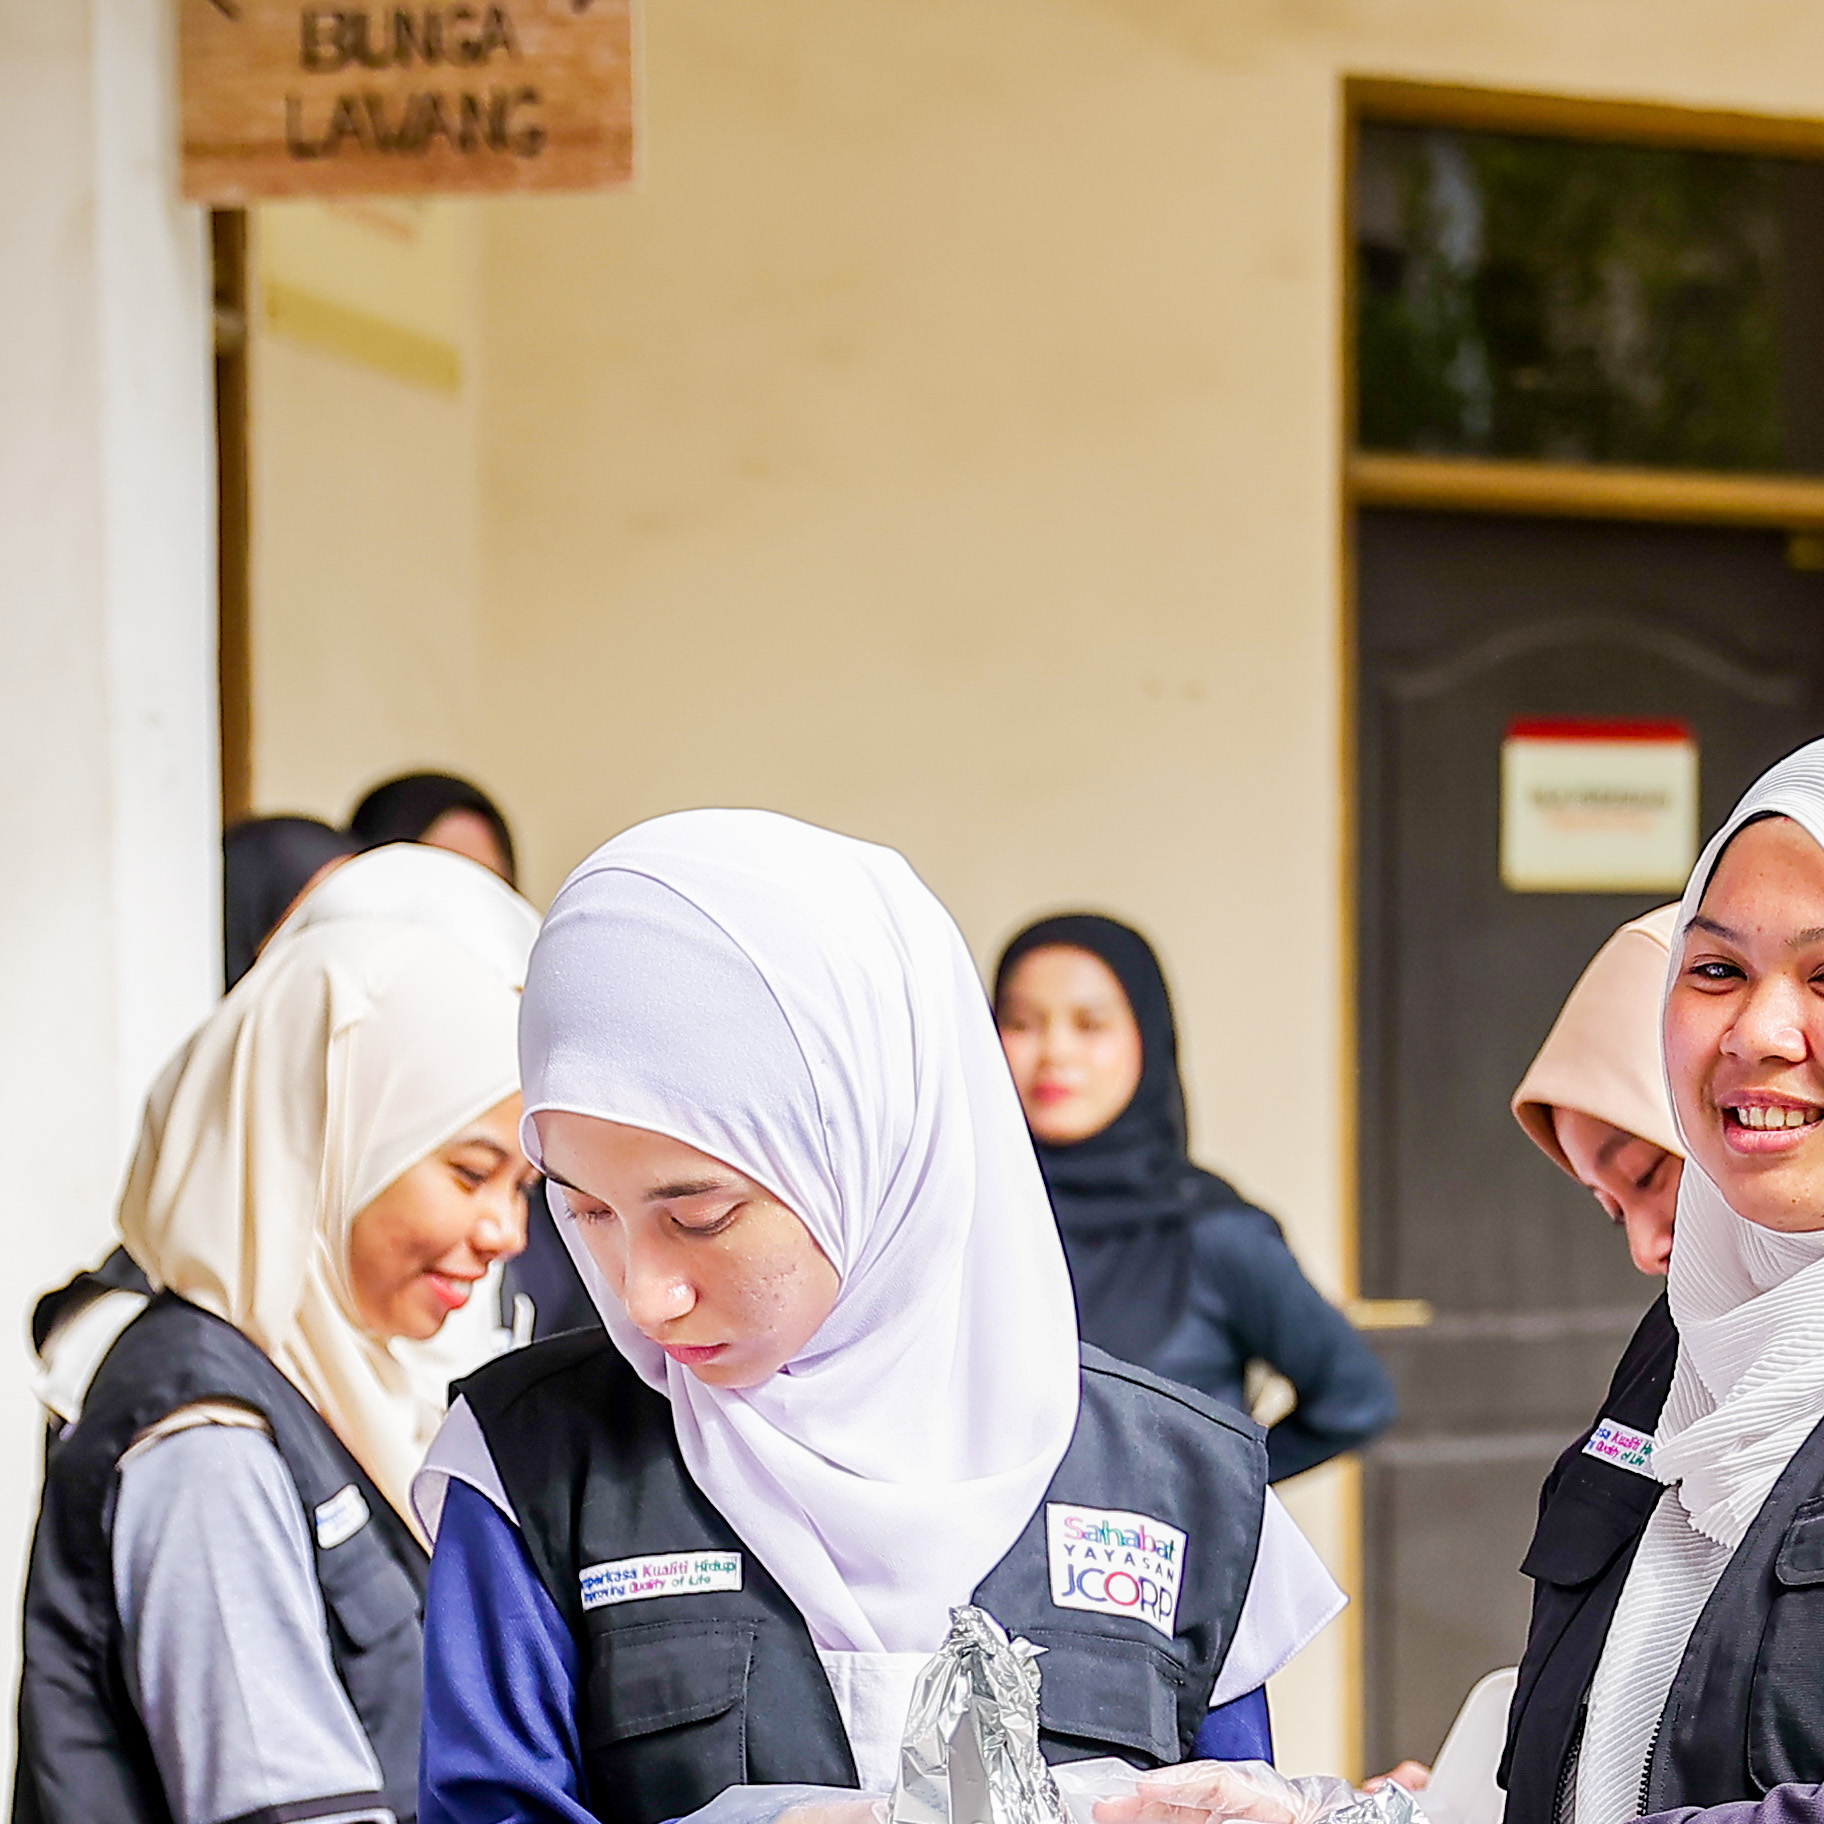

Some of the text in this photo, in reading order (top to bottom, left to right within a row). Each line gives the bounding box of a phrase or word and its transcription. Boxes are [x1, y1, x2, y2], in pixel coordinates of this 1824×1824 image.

[299, 6, 519, 73] BUNGA
[283, 85, 547, 160] LAWANG
[1064, 1516, 1176, 1564] Sahabat
[1064, 1543, 1174, 1583] YAYASAN
[630, 1578, 666, 1594] Quality
[671, 1576, 684, 1588] of
[689, 1574, 711, 1586] Life
[643, 1560, 688, 1578] Kualiti
[695, 1559, 736, 1574] Hidup
[1061, 1563, 1173, 1622] JCORP
